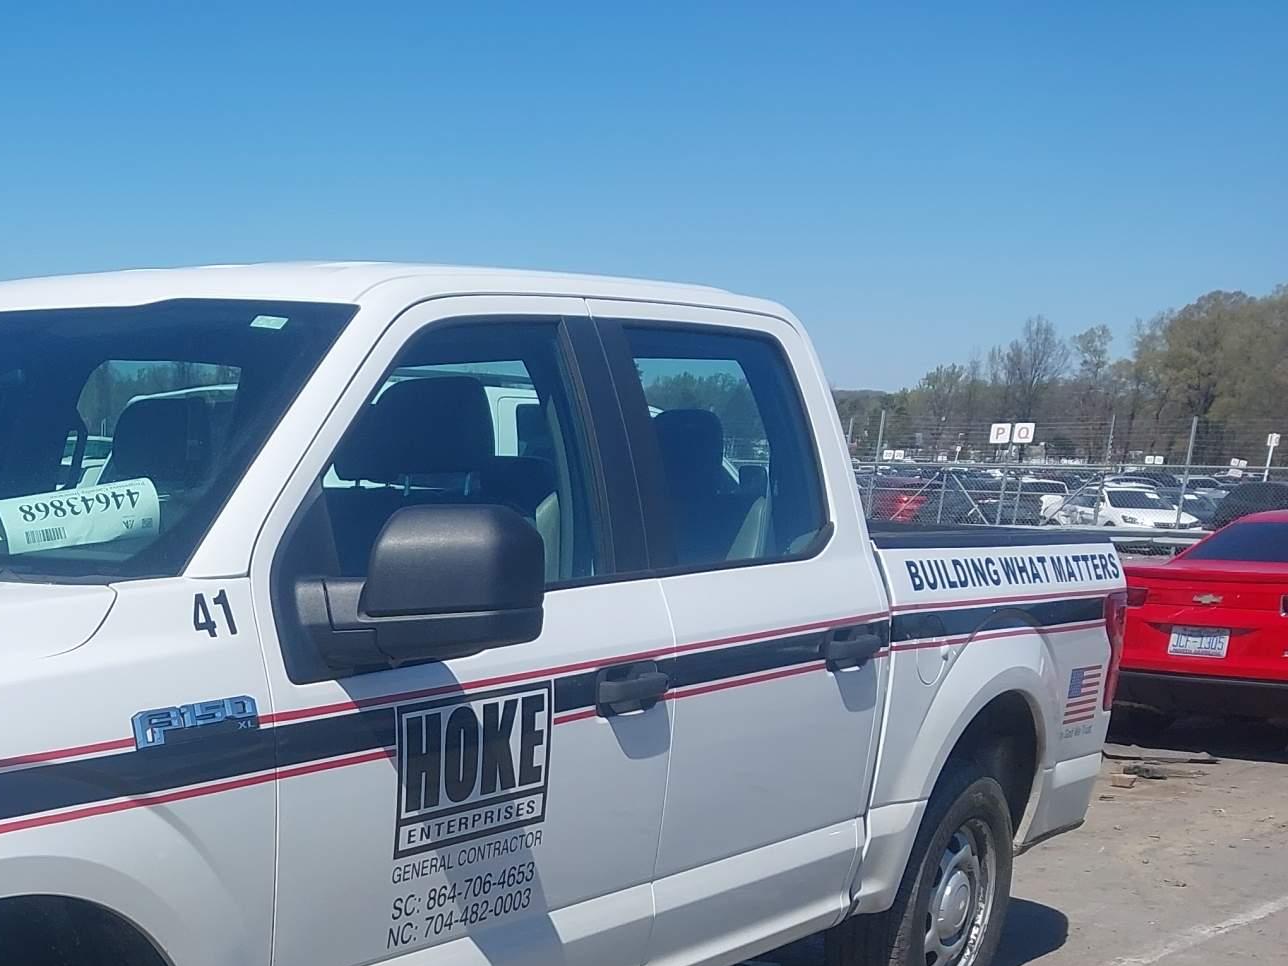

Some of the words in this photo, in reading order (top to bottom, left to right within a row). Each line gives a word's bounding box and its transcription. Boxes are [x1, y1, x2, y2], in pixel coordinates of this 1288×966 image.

[996, 427, 1006, 440] P
[1017, 426, 1030, 440] Q
[18, 488, 140, 522] 44643868
[905, 557, 1002, 592] BUILDING
[998, 555, 1052, 585] WHAT
[1050, 553, 1120, 583] MATTERS
[193, 589, 238, 638] 41
[237, 721, 255, 729] XL
[404, 693, 545, 814] HOKE
[407, 799, 537, 845] ENTERPRISES
[392, 852, 454, 884] GENERAL
[458, 830, 543, 867] CONTRACTOR
[391, 893, 422, 921] SC:
[426, 861, 536, 911] 864-706-4653
[387, 922, 418, 949] NC:
[424, 888, 532, 939] 704-482-0003
